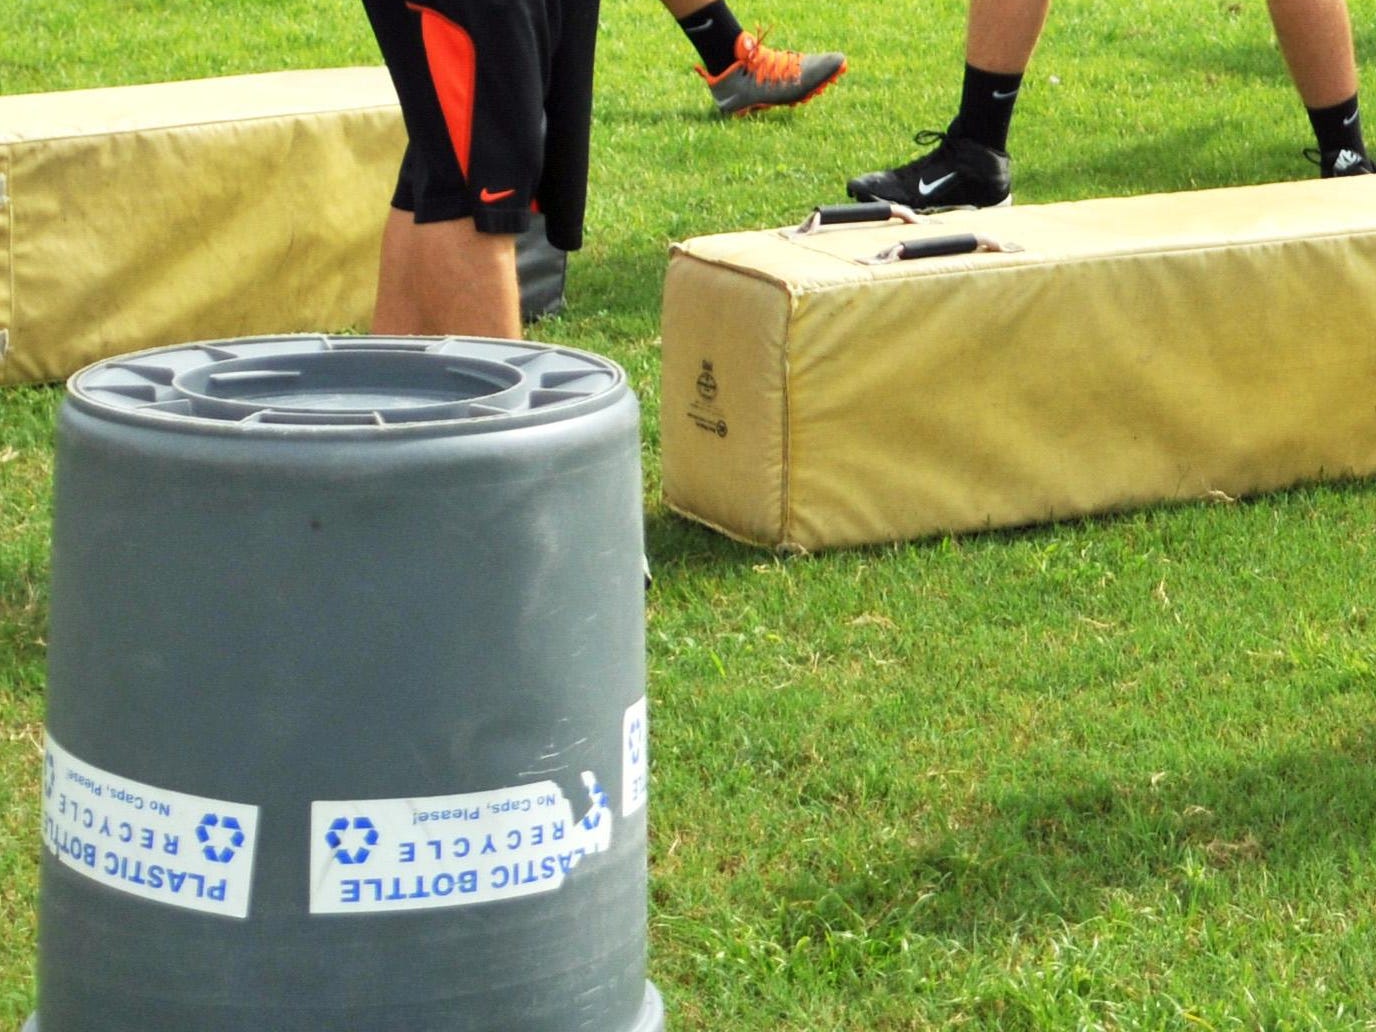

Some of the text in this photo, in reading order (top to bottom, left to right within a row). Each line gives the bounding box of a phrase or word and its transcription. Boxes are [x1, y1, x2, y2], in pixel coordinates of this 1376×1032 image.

[105, 784, 144, 810] Caps,
[149, 800, 171, 817] No
[411, 793, 556, 825] No Caps, Please!
[58, 793, 180, 856] RECYCLE
[398, 819, 565, 864] RECYCLE
[104, 851, 228, 902] PLASTIC
[339, 870, 478, 904] BOTTLE
